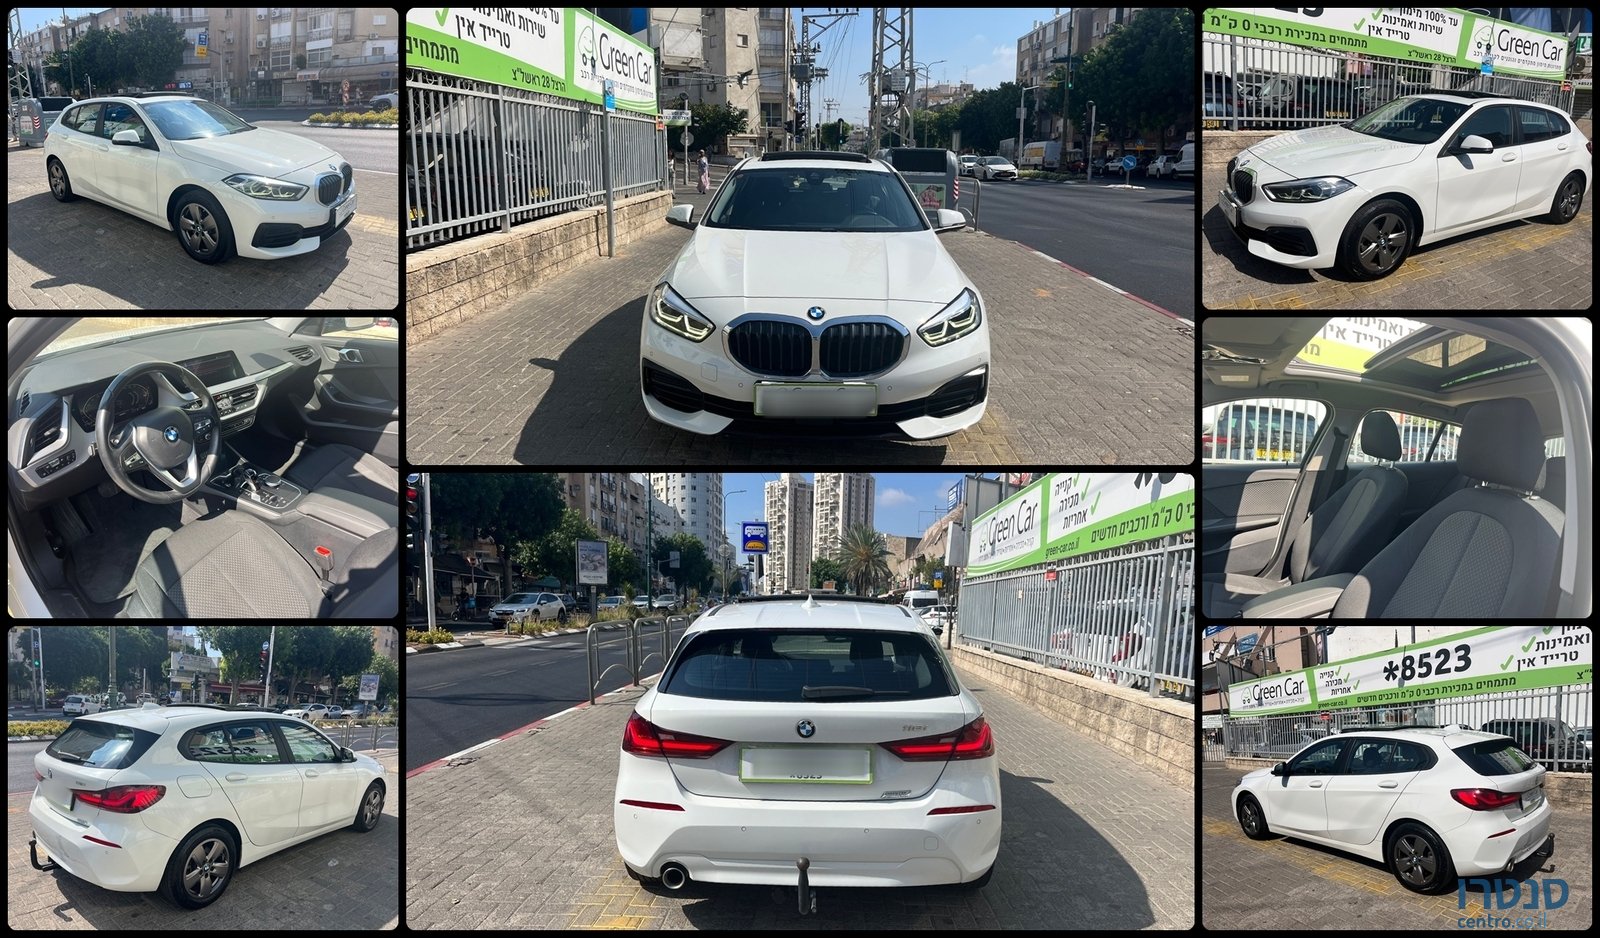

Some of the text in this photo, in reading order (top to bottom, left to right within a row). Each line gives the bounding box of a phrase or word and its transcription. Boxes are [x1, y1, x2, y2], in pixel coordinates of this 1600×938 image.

[1242, 19, 1250, 31] 0
[1382, 14, 1443, 34] שירות ואמינות
[1425, 10, 1446, 24] 100%
[1448, 16, 1458, 26] עד
[456, 14, 510, 48] טרייד אין
[518, 14, 546, 39] שירות
[1255, 22, 1282, 36] רכבי
[1286, 26, 1326, 42] במכירת
[1368, 24, 1410, 40] טרייד אין
[1330, 34, 1368, 48] מתמחים
[1498, 29, 1538, 58] Green
[1542, 40, 1563, 62] Car
[406, 36, 460, 64] מתמחים
[1434, 54, 1440, 62] 28
[600, 33, 652, 84] Green Car
[1443, 55, 1456, 63] הרצל
[541, 75, 550, 88] 28
[551, 77, 566, 92] הרצל
[1323, 324, 1347, 340] אין
[1054, 477, 1072, 496] קנייה
[1058, 492, 1079, 512] מכירה
[1063, 508, 1088, 529] אחריות
[1176, 502, 1183, 523] 0
[988, 500, 1038, 546] Green Car
[1120, 515, 1149, 536] ורכבים
[1091, 524, 1117, 543] חדשים
[1535, 633, 1590, 652] ואמינות
[1517, 650, 1578, 672] טרייד אין
[1320, 670, 1334, 680] קנייה
[1326, 678, 1342, 687] מכירה
[1476, 676, 1516, 689] מתמחים
[1252, 678, 1304, 702] Green Car
[1331, 686, 1351, 696] אחריות
[1422, 687, 1440, 696] רכבי
[1442, 682, 1473, 694] במכירת
[1357, 694, 1377, 703] חדשים
[1378, 692, 1400, 701] ורכבים
